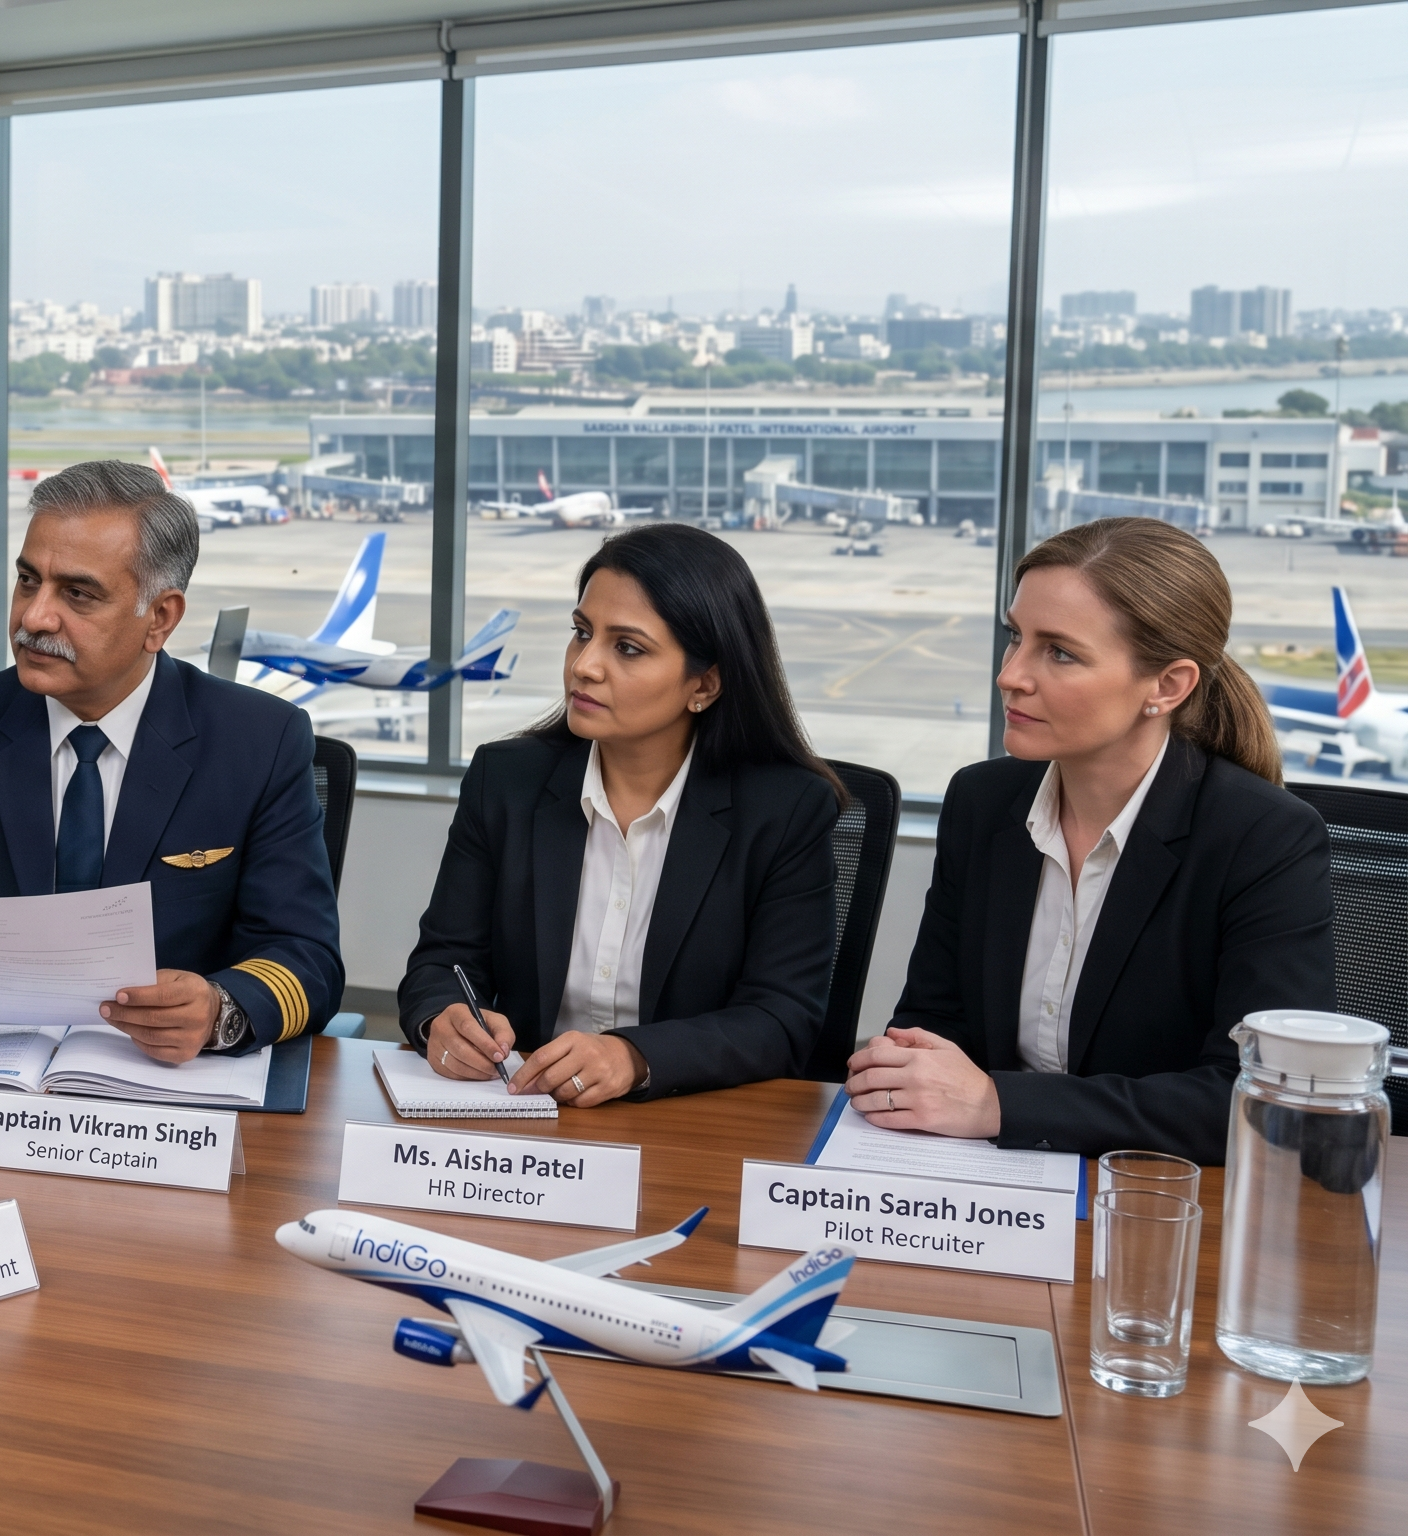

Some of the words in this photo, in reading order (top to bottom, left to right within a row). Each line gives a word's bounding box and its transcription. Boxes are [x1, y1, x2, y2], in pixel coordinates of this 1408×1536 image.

[583, 423, 629, 433] SARDAR
[718, 424, 755, 434] PATEL
[759, 424, 857, 435] INTERNATIONAL
[861, 424, 917, 435] AIRPORT
[69, 1113, 148, 1141] Vikram
[155, 1122, 218, 1150] Singh
[26, 1141, 84, 1162] Senior
[89, 1147, 158, 1169] Captain
[393, 1143, 436, 1167] Ms.
[445, 1148, 513, 1173] Aisha
[521, 1154, 584, 1180] Patel
[428, 1179, 456, 1197] HR
[463, 1182, 545, 1206] Director
[768, 1181, 871, 1212] Captain
[879, 1192, 957, 1221] Sarah
[965, 1201, 1045, 1230] Jones
[352, 1229, 446, 1278] IndiGo
[824, 1220, 873, 1243] Pilot
[881, 1227, 985, 1255] Recruiter
[788, 1248, 843, 1285] IndiGo
